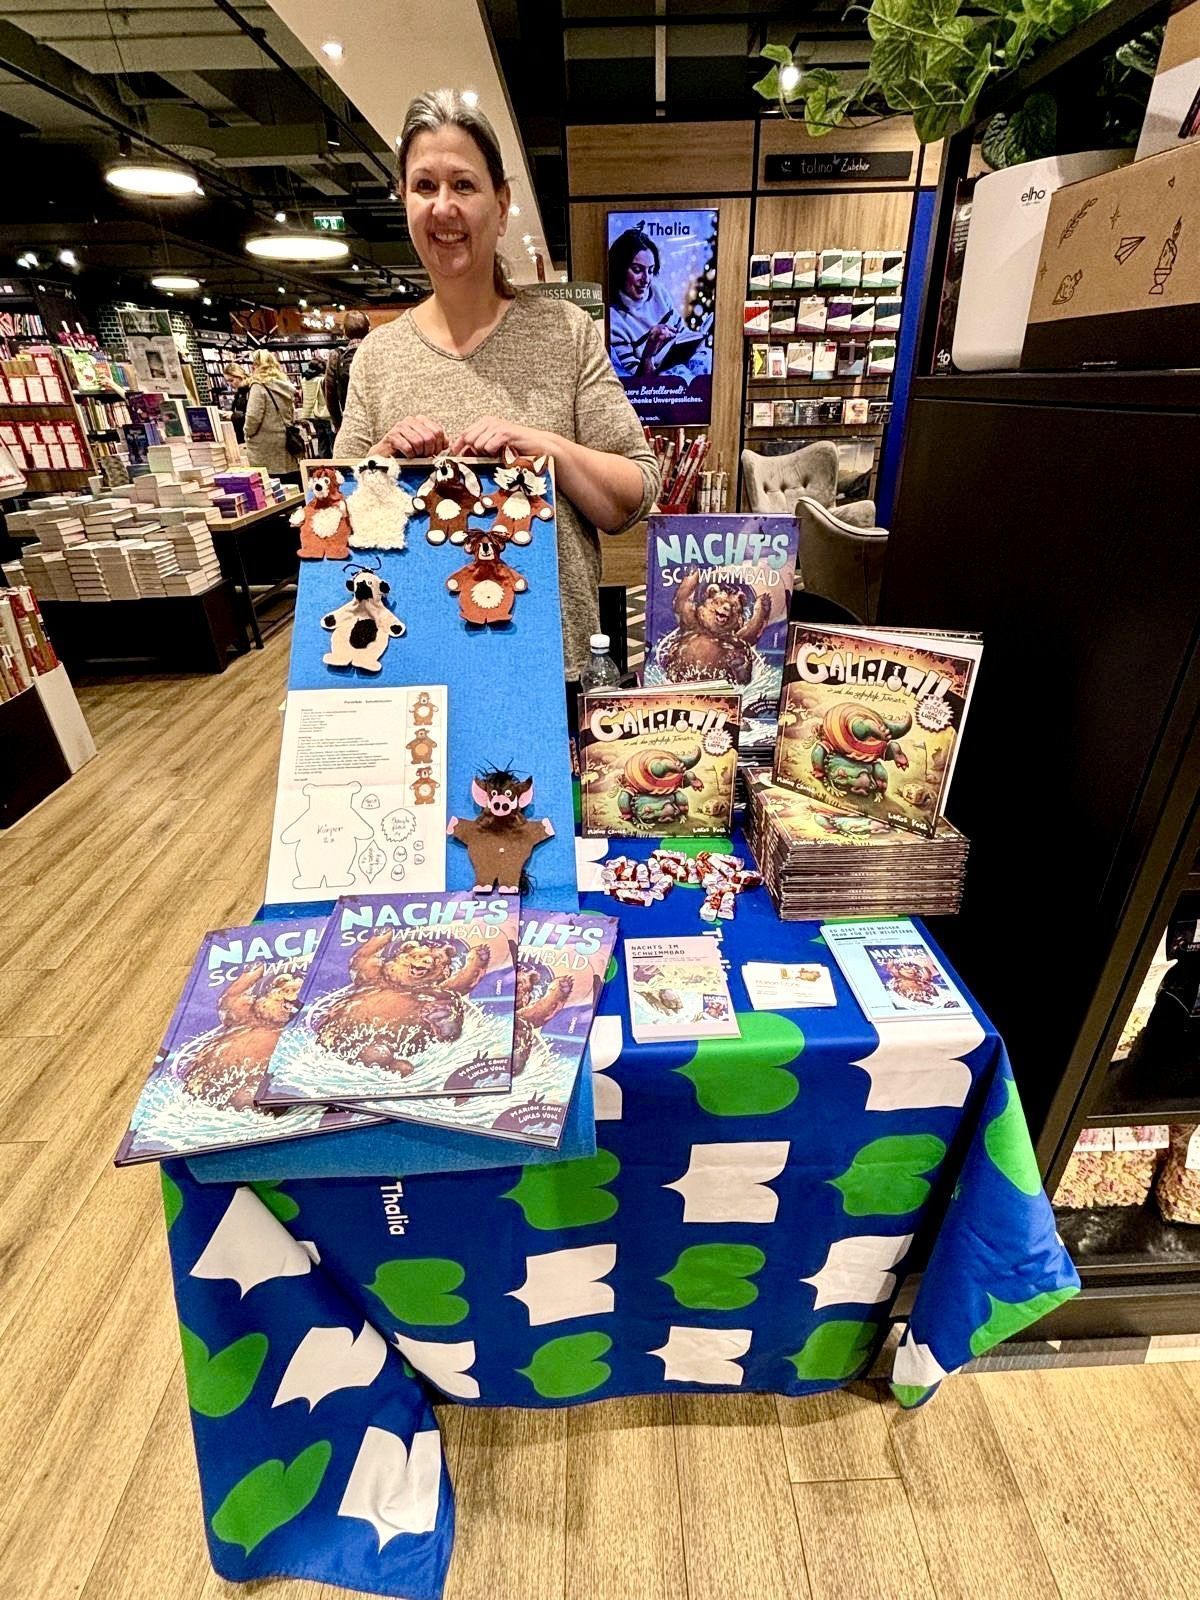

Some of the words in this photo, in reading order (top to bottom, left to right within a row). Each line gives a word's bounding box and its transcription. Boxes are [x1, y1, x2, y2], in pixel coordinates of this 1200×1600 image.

[801, 158, 833, 174] tolino
[1021, 186, 1046, 202] elho
[647, 222, 690, 236] Thalia
[543, 289, 573, 299] ISSEN
[575, 288, 591, 299] DER
[656, 532, 789, 570] NACHTS
[661, 566, 780, 588] SCWIMMBAD
[317, 824, 343, 836] Körper
[341, 900, 508, 932] NACHTS
[340, 925, 500, 947] SCWIMMBAD
[208, 928, 326, 970] NACH
[459, 1062, 486, 1077] MARION
[467, 1068, 489, 1080] LUKAS
[510, 1105, 540, 1118] MARION
[518, 1112, 541, 1124] LUKAS
[380, 1181, 409, 1235] Thalia
